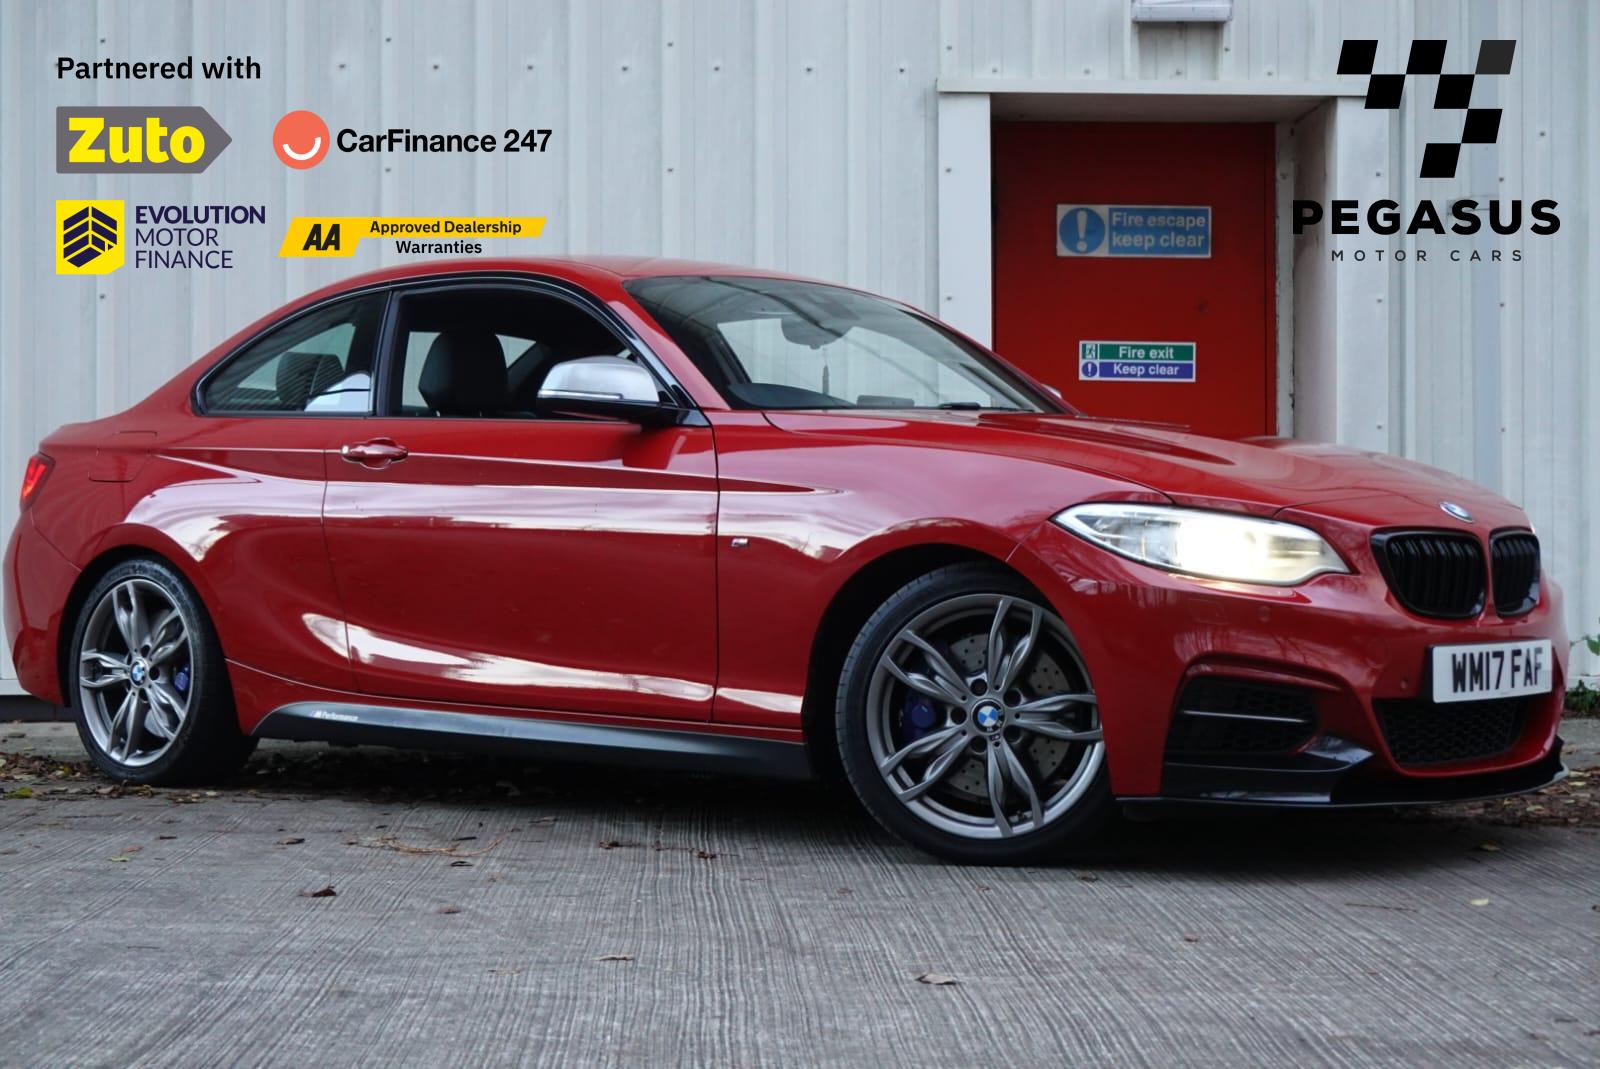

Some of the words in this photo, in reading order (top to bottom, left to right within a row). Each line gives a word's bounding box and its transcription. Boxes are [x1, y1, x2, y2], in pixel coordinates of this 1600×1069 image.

[1112, 212, 1143, 226] Fire
[1147, 215, 1206, 230] escape
[1112, 232, 1155, 250] keep
[1160, 234, 1205, 248] clear
[1119, 346, 1145, 359] Fire
[1149, 346, 1174, 359] exit
[1113, 363, 1145, 377] Keep
[1148, 363, 1180, 375] clear
[1452, 650, 1504, 693] WM17
[1511, 647, 1542, 688] FAF
